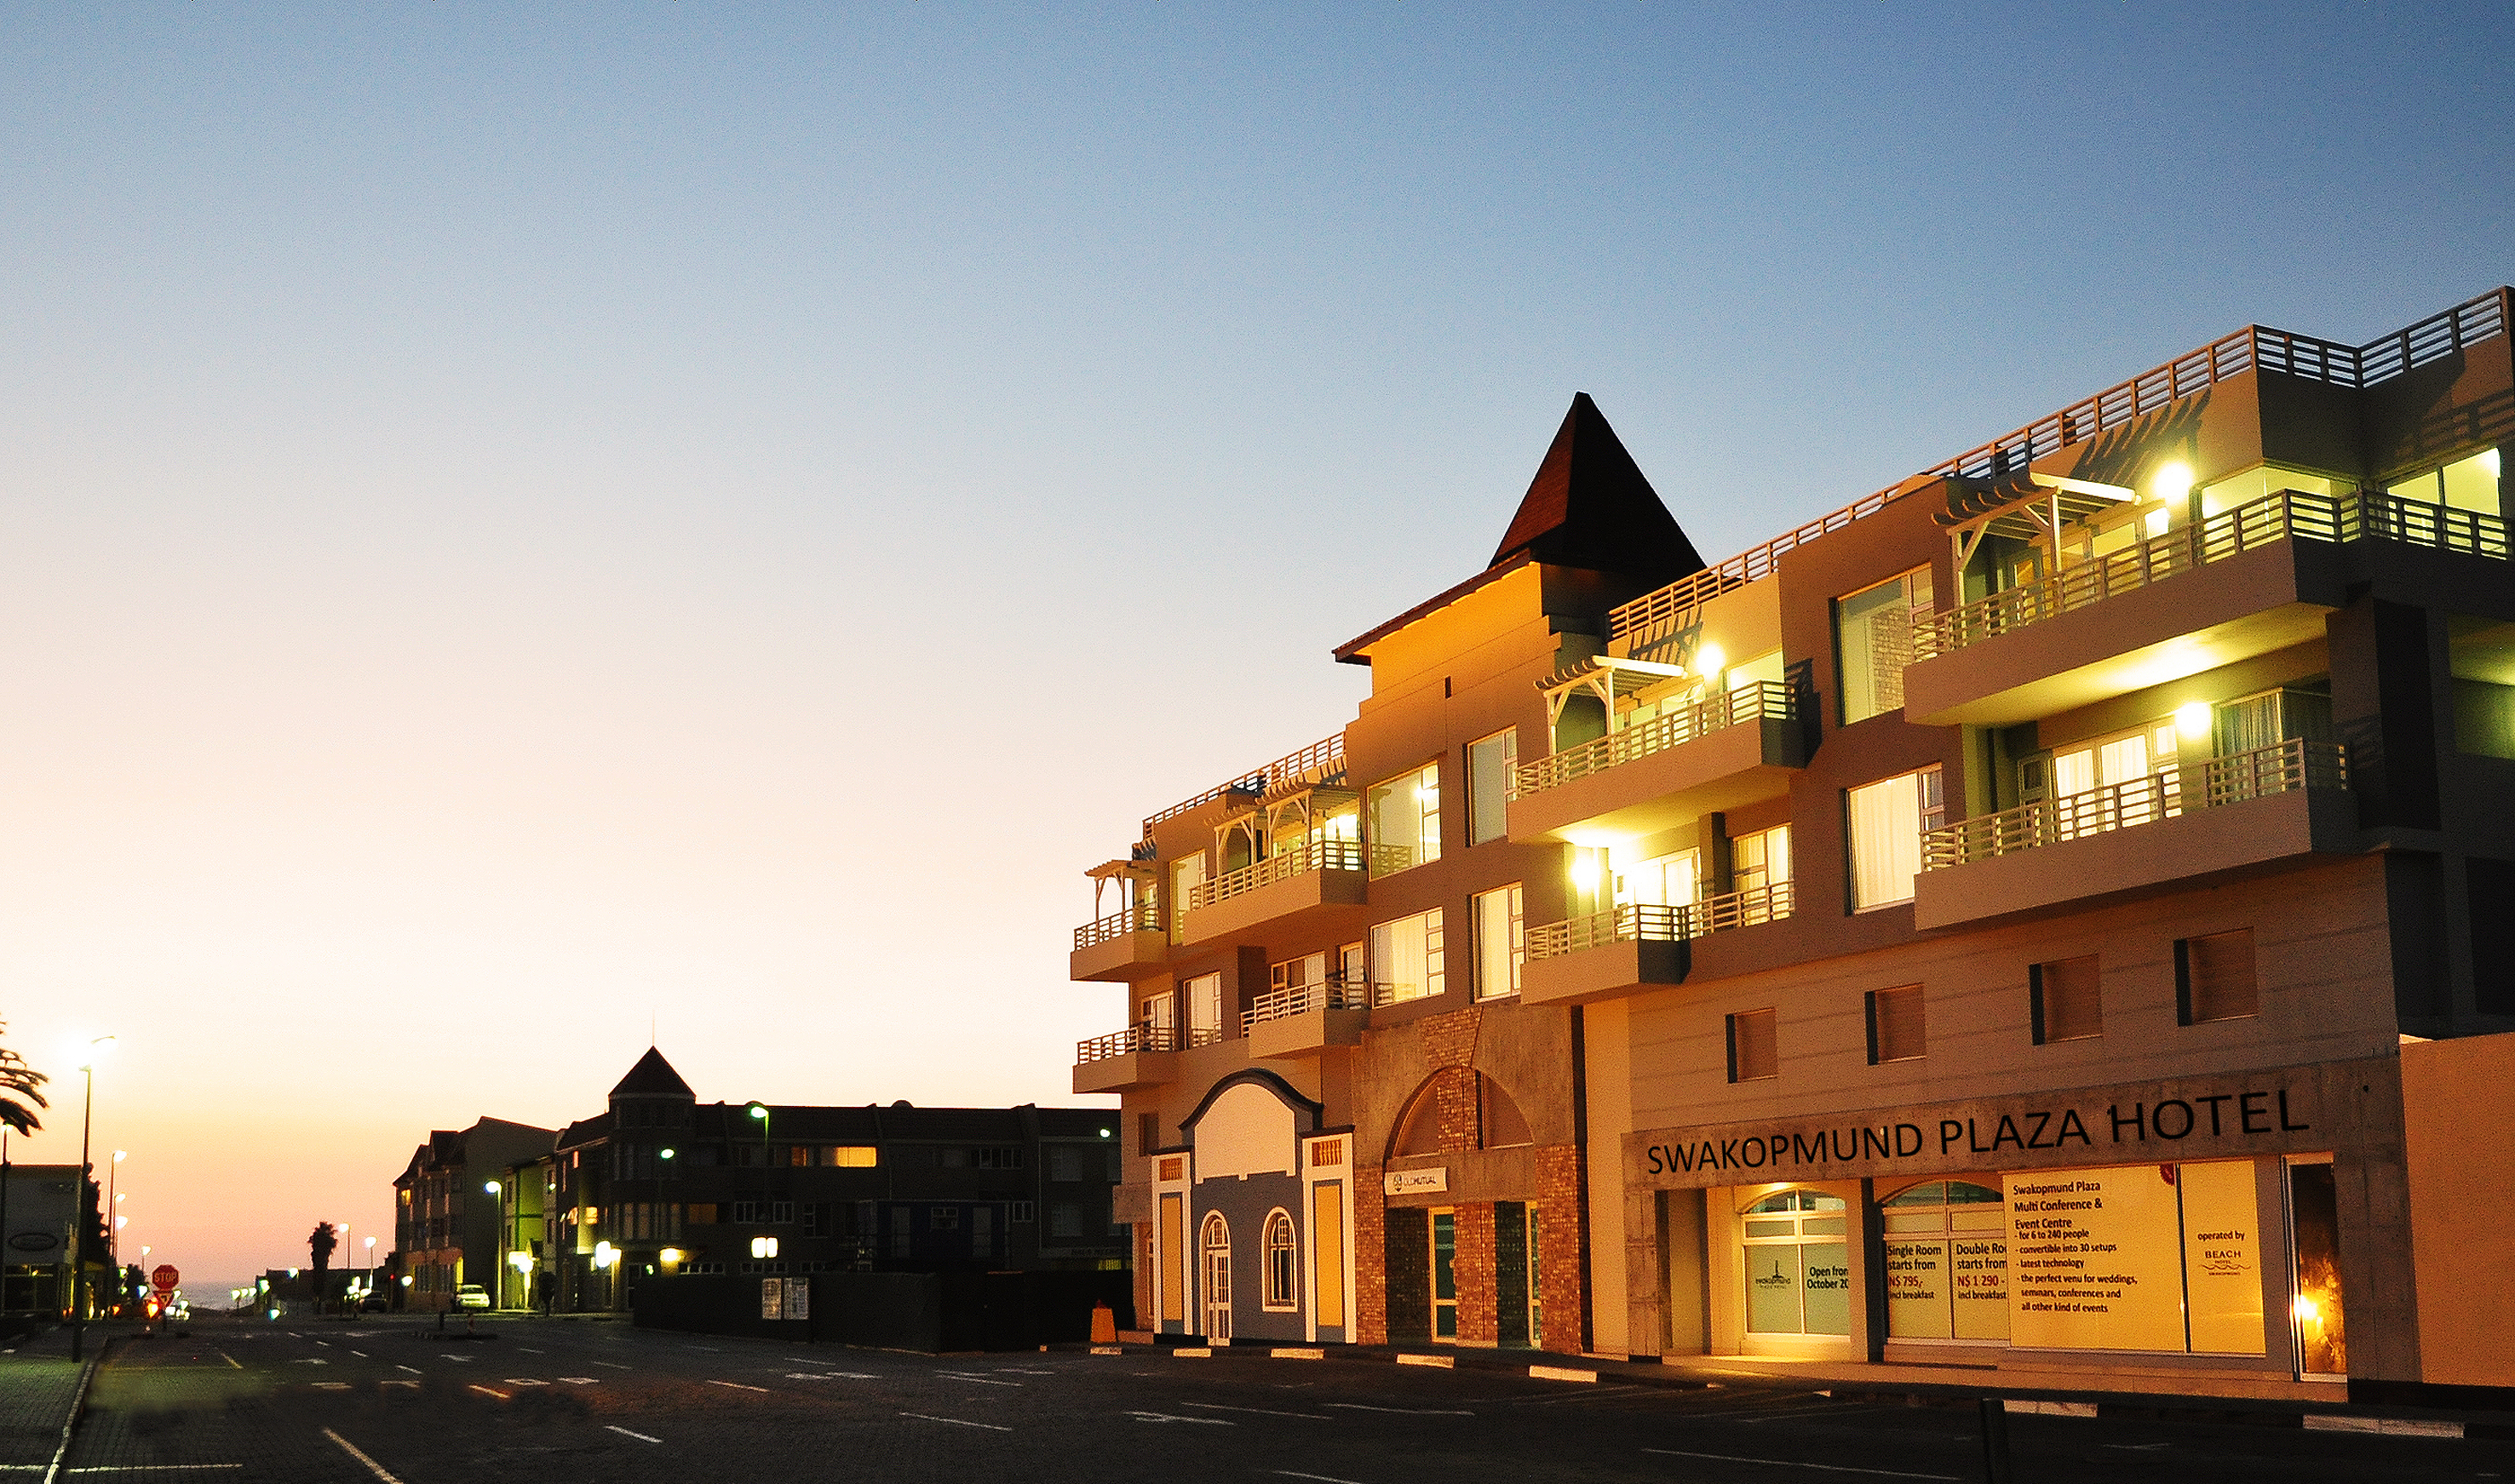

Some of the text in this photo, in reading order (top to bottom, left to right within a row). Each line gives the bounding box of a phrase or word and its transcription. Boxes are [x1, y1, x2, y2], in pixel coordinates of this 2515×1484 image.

[1647, 1089, 2311, 1174] SWAKOPMUND PLAZA HOTEL
[2013, 1180, 2101, 1195] Swakopmund Plaza
[2014, 1197, 2103, 1212] Multi Conference &
[2014, 1218, 2072, 1229] Event Centre
[2018, 1231, 2030, 1240] for
[2031, 1231, 2036, 1240] 6
[2047, 1230, 2061, 1239] 240
[2063, 1229, 2089, 1240] people
[2197, 1230, 2245, 1242] operated by
[1887, 1244, 1942, 1258] Single Room
[1956, 1242, 1990, 1255] Double
[2019, 1244, 2061, 1253] convertible
[2063, 1244, 2078, 1253] into
[2080, 1243, 2089, 1252] 30
[2091, 1243, 2117, 1253] setups
[2205, 1250, 2241, 1259] BEACH
[1888, 1258, 1937, 1270] starts from
[1957, 1257, 2007, 1269] starts from
[2020, 1258, 2041, 1268] latest
[2042, 1258, 2085, 1269] technology
[154, 1272, 177, 1283] STOP
[1809, 1266, 1831, 1278] Open
[1806, 1278, 1838, 1289] October
[1888, 1275, 1901, 1288] N$
[1957, 1275, 1971, 1288] N$
[1973, 1275, 1978, 1286] 1
[1982, 1275, 1999, 1286] 290
[2021, 1274, 2033, 1283] the
[2035, 1274, 2062, 1284] perfect
[2063, 1275, 2082, 1283] venu
[2084, 1274, 2095, 1283] for
[2097, 1274, 2138, 1286] weddings,
[1903, 1290, 1935, 1300] breakfast
[1972, 1290, 2007, 1300] breakfast
[2021, 1288, 2122, 1298] seminars, conferences and
[2022, 1302, 2109, 1313] all other kind of events
